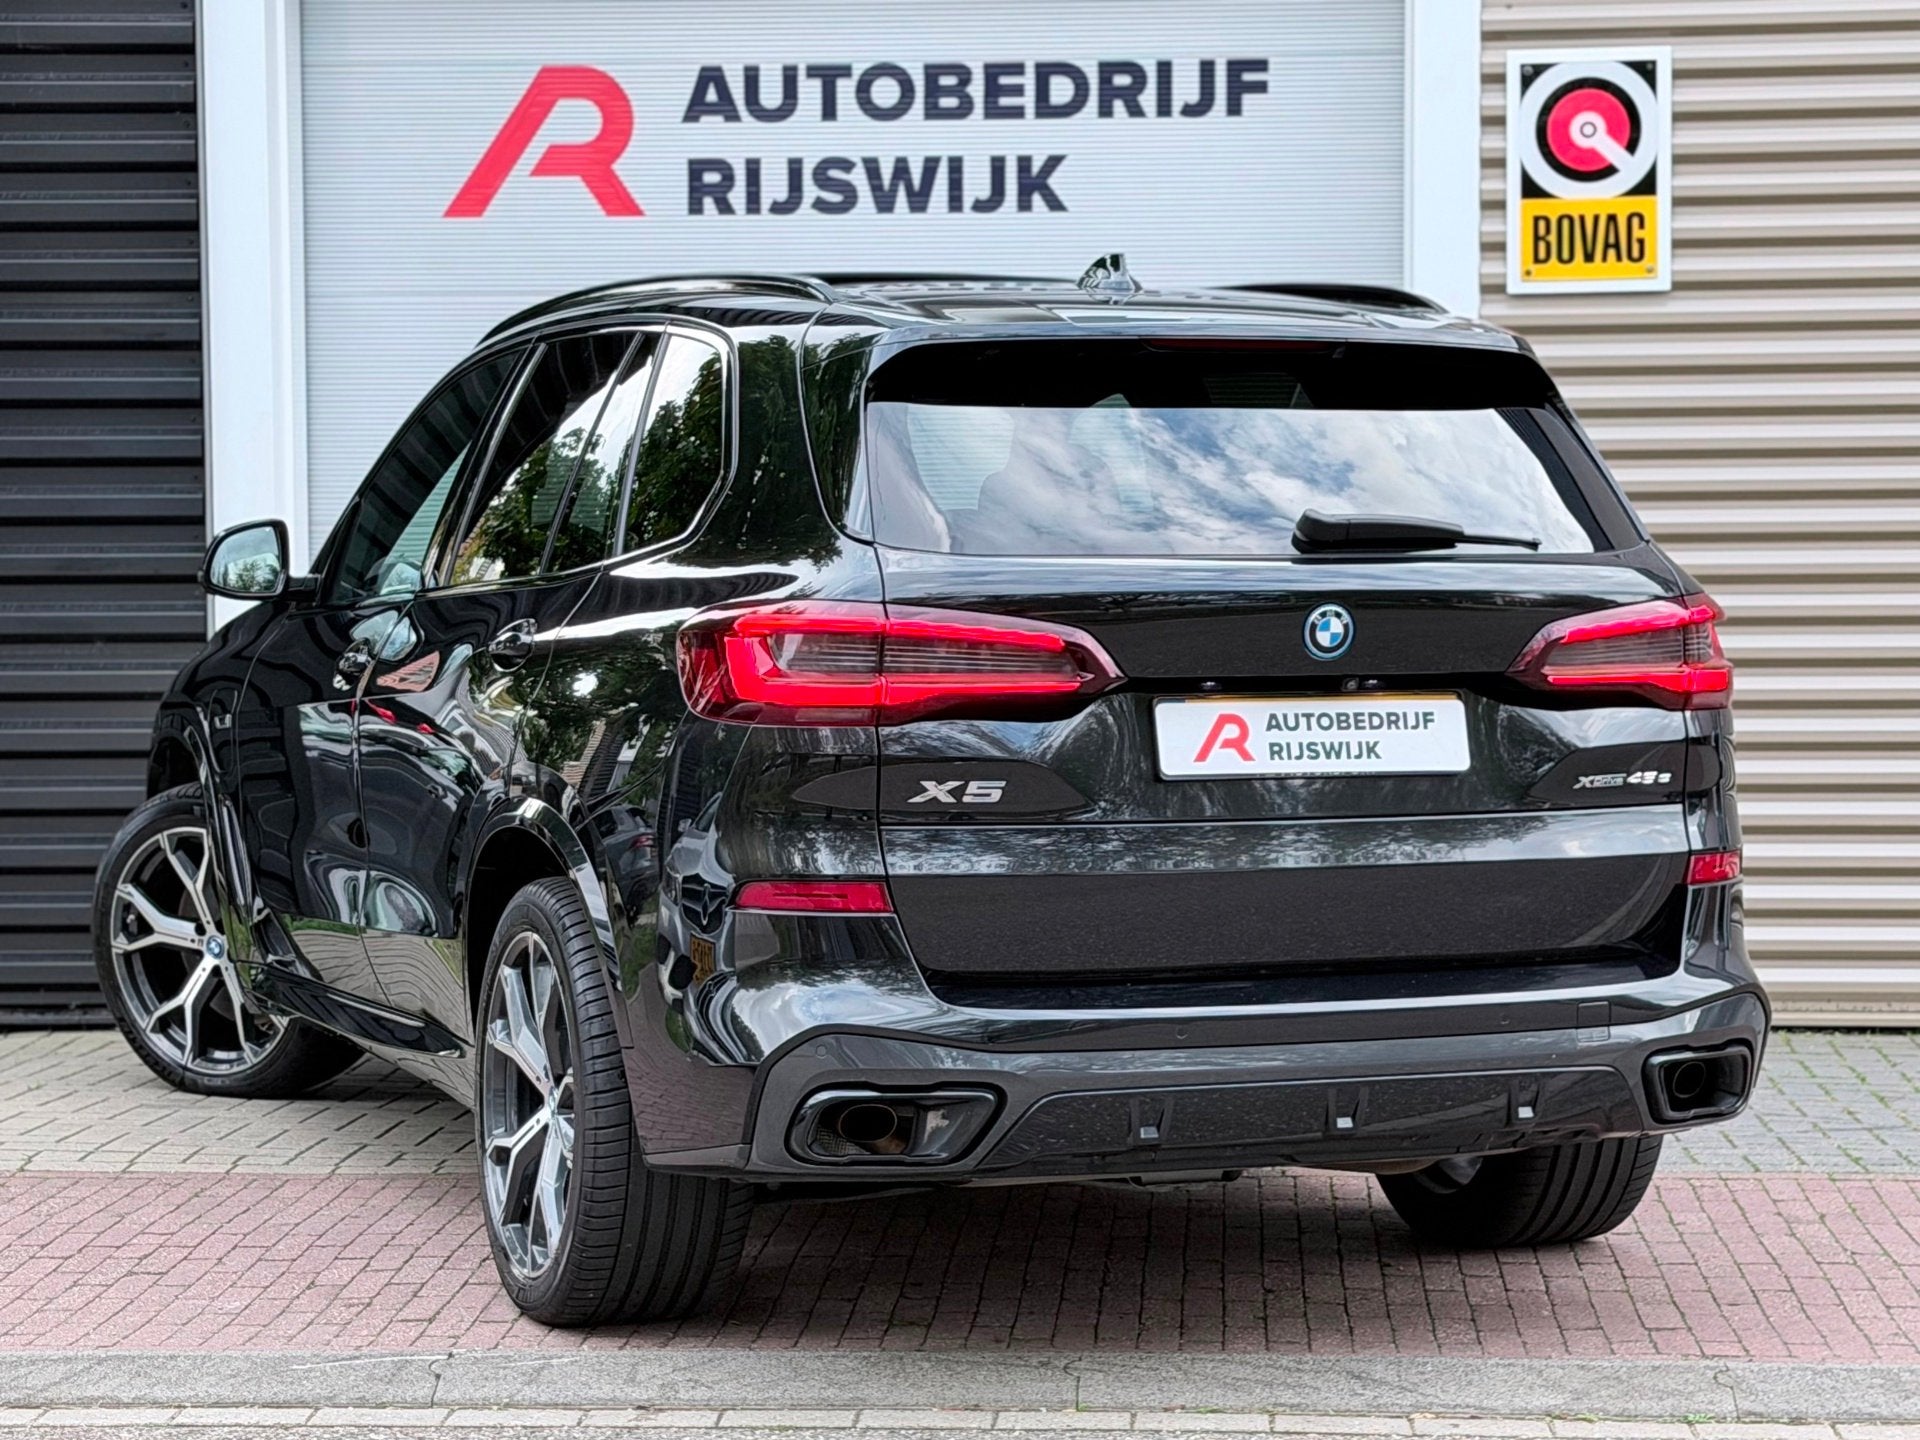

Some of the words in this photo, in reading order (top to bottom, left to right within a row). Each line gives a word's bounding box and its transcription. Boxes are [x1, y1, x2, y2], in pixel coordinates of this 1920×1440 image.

[681, 58, 1269, 123] AUTOBEDRIJF
[687, 154, 1069, 216] RIJSWIJK
[1532, 211, 1646, 265] BOVAG
[1265, 711, 1436, 732] AUTOBEDRIJF
[1268, 740, 1382, 761] RIJSWIJK
[906, 780, 1008, 803] X5
